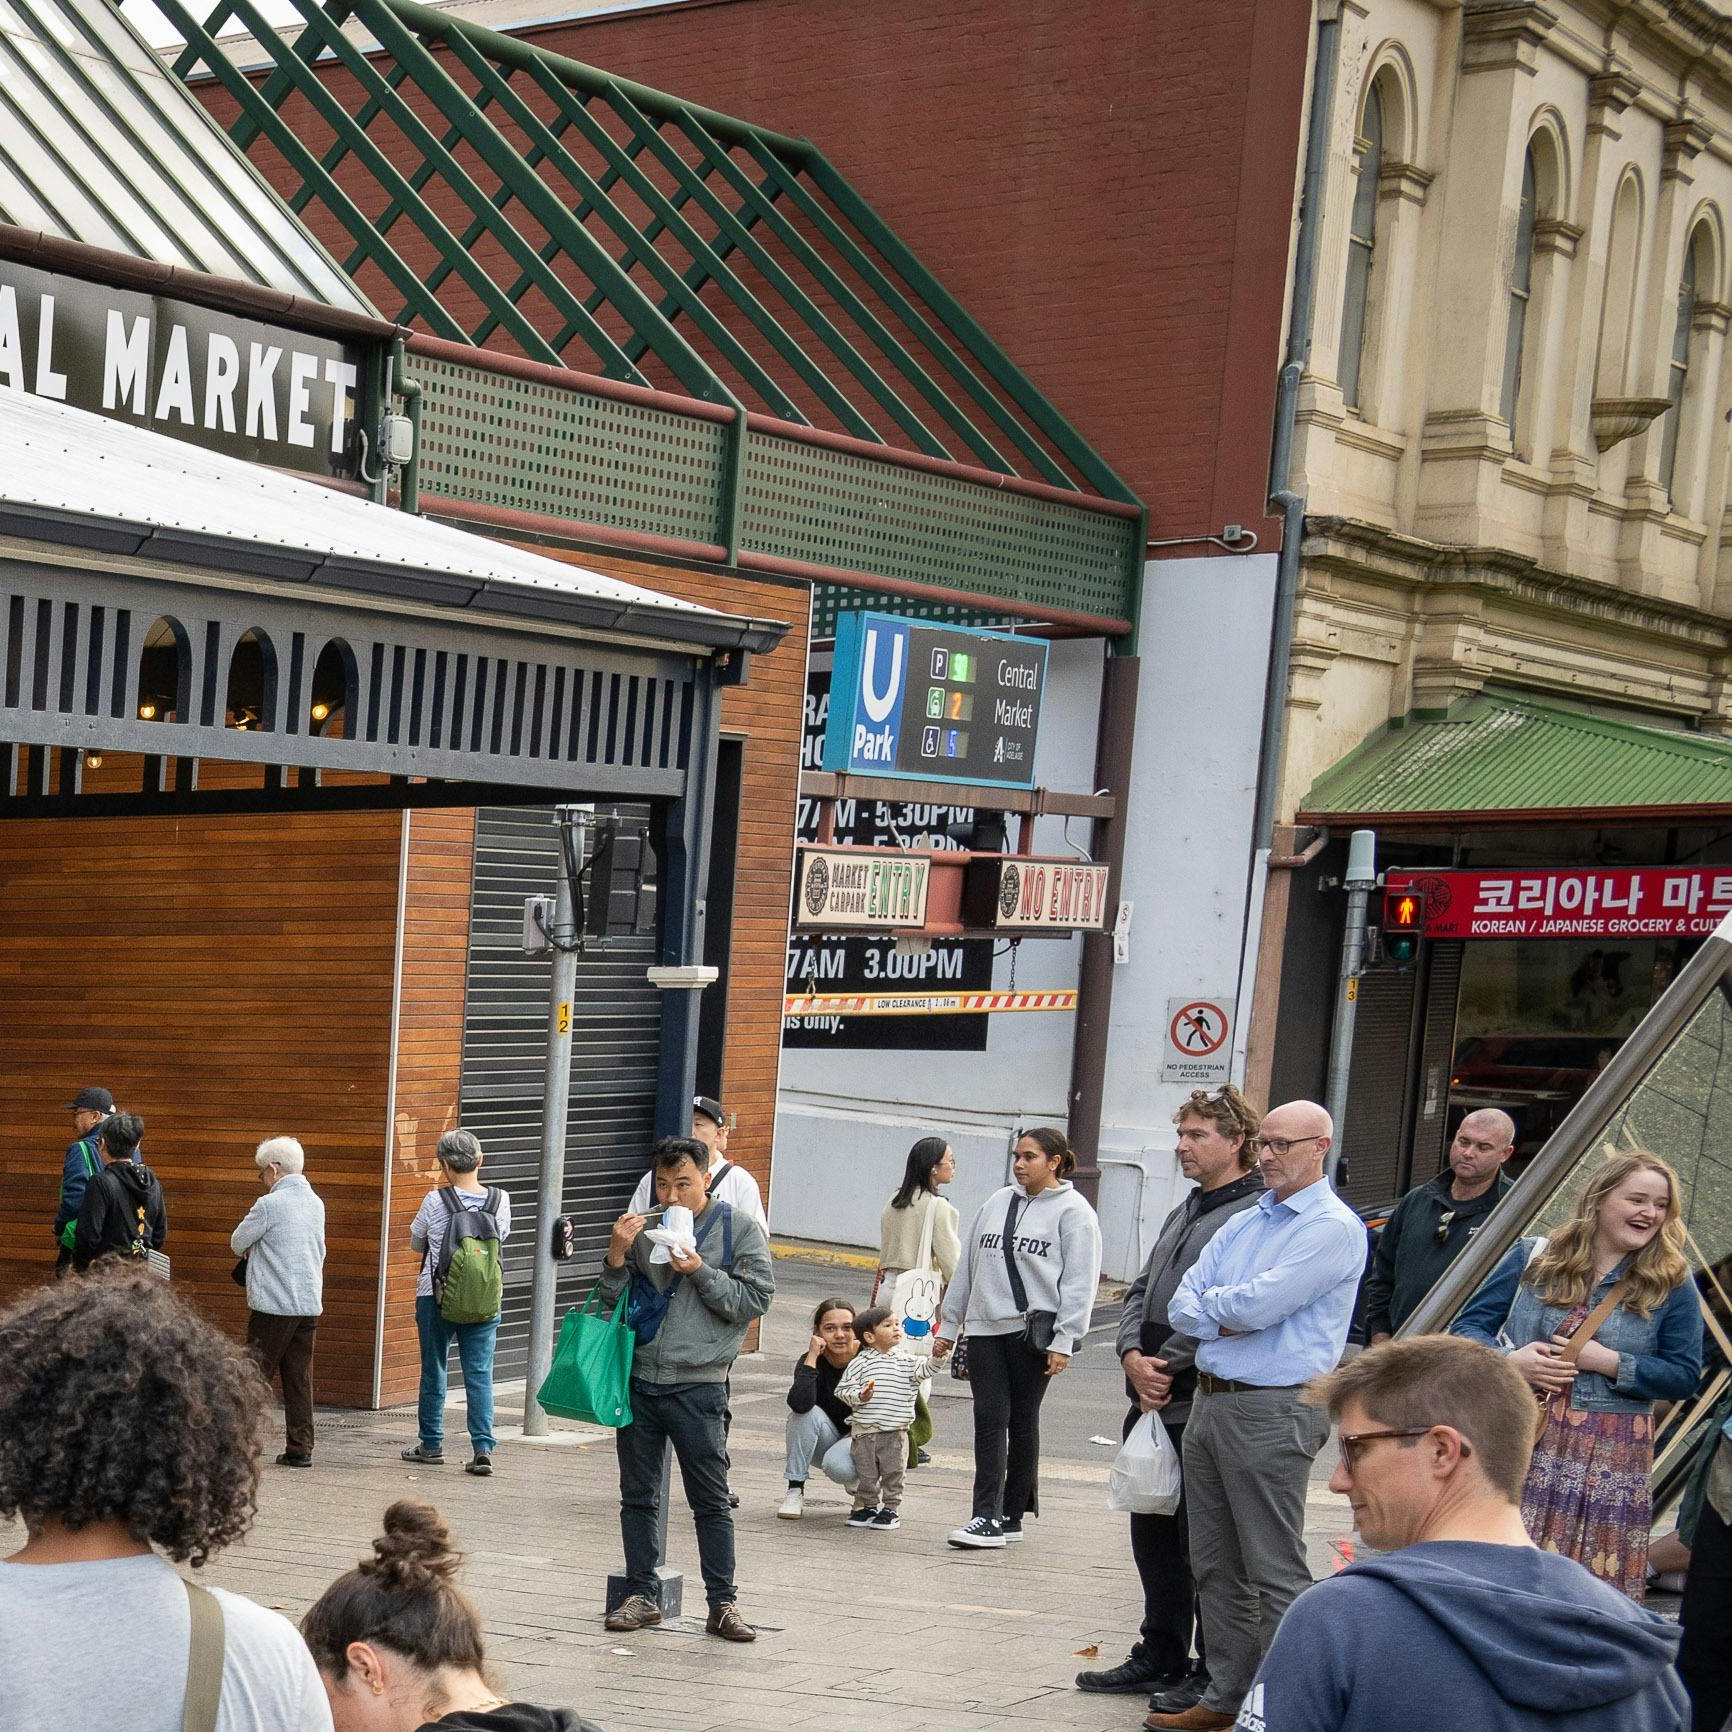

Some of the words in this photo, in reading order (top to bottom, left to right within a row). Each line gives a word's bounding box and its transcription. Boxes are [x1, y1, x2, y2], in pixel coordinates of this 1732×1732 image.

[102, 307, 357, 454] MARKET
[862, 629, 903, 722] U
[997, 659, 1038, 690] Central
[994, 698, 1033, 728] Market
[853, 724, 895, 762] Park
[833, 862, 869, 889] MARKET
[868, 860, 925, 919] ENTRY
[830, 891, 867, 913] CARPARK
[1020, 865, 1046, 920] NO
[1049, 866, 1108, 922] ENTRY
[1473, 875, 1643, 916] 코리아나
[1471, 920, 1526, 933] KOREAN
[1539, 919, 1604, 933] JAPANESE
[1609, 919, 1673, 932] GROCERY
[1676, 919, 1686, 932] &
[864, 948, 964, 978] 3.00PM
[1017, 1236, 1052, 1257] FOX
